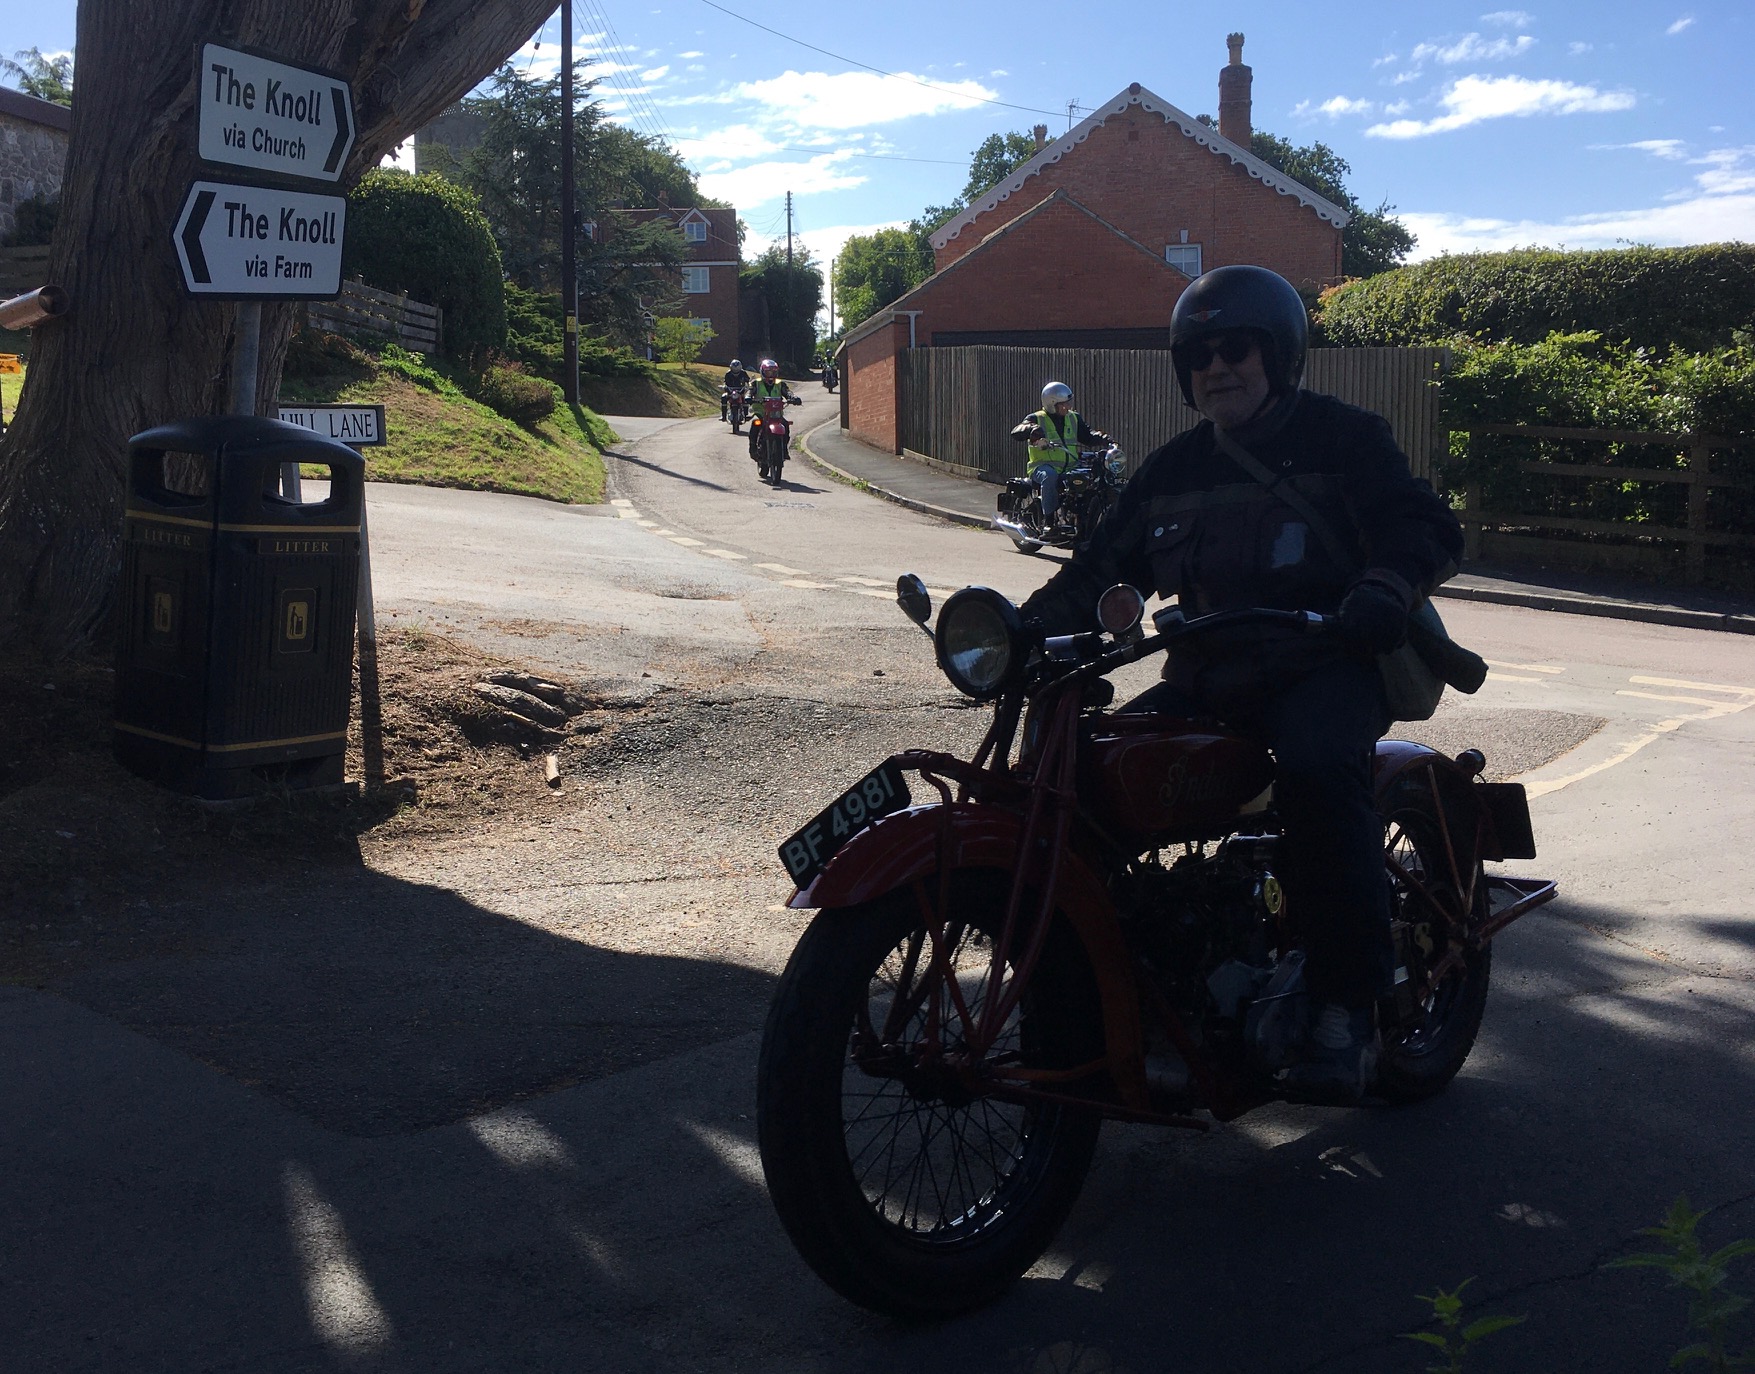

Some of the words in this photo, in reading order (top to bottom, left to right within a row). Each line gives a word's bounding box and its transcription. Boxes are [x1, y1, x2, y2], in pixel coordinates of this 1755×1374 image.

[211, 63, 256, 110] The
[265, 78, 322, 126] Knoll
[223, 122, 246, 149] via
[252, 127, 306, 160] Church
[224, 201, 269, 240] The
[278, 207, 336, 244] Knoll
[245, 254, 268, 278] via
[274, 255, 312, 279] Farm
[329, 413, 373, 438] LANE
[143, 528, 192, 546] LITTER
[275, 540, 330, 552] LITTER
[784, 822, 824, 876] BF
[832, 768, 895, 837] 4981
